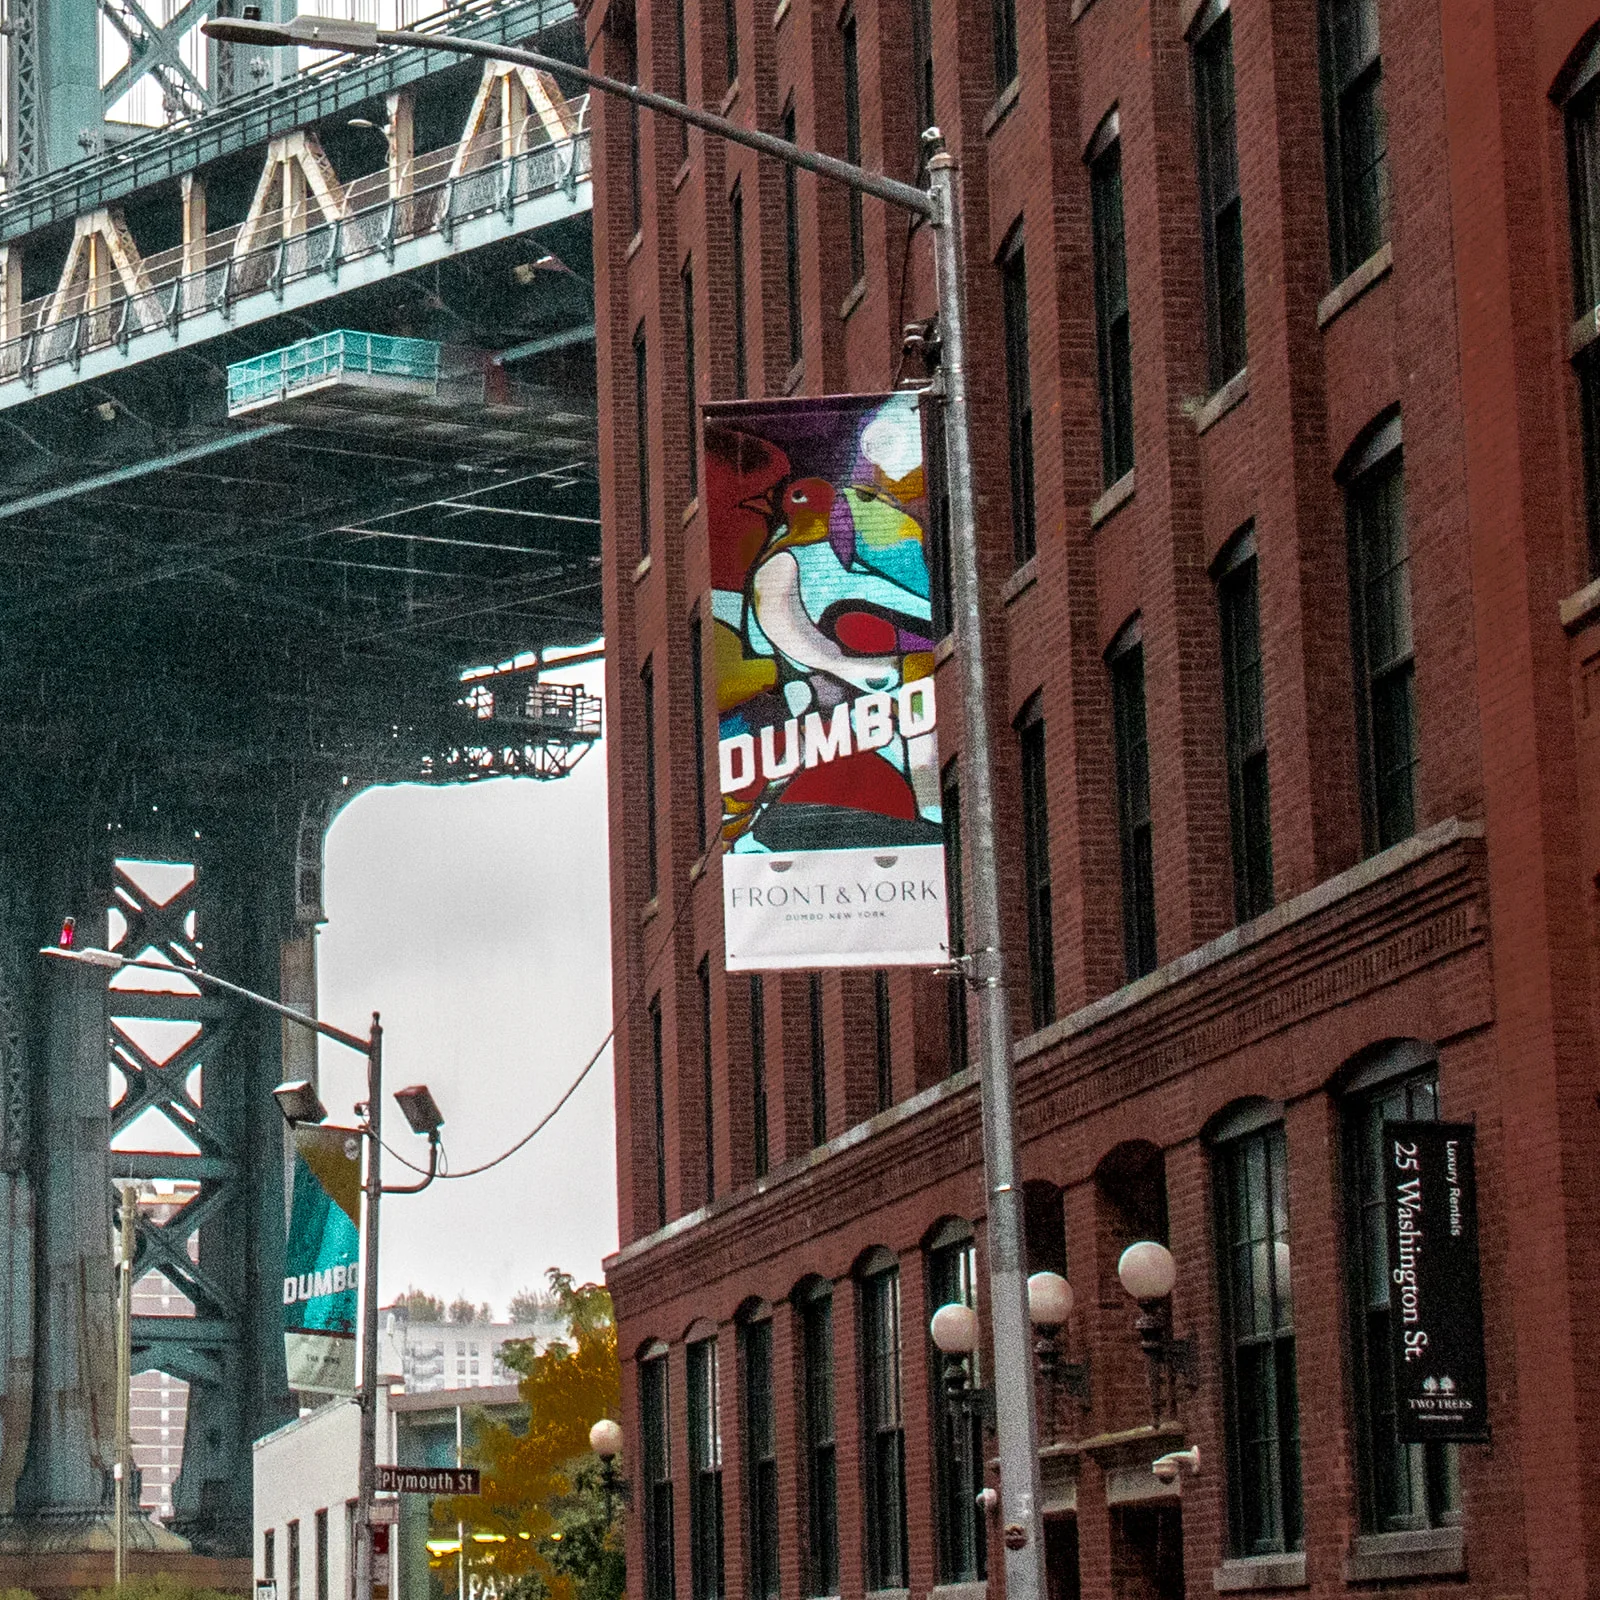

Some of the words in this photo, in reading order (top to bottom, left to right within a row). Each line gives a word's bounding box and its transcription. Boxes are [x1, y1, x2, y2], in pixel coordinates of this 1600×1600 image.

[719, 677, 937, 794] DUMBO
[786, 913, 824, 921] DUMBO
[829, 912, 851, 920] NEW
[858, 910, 887, 918] YORK
[1394, 1141, 1419, 1171] 25
[1446, 1141, 1458, 1184] Luxury
[1449, 1187, 1462, 1237] Rentals
[1393, 1178, 1423, 1323] Washington
[283, 1261, 359, 1305] DUMBO
[1404, 1331, 1429, 1362] St.
[1408, 1399, 1435, 1409] TWO
[1436, 1399, 1473, 1409] TREES
[382, 1471, 453, 1492] Plymouth
[458, 1473, 473, 1490] St
